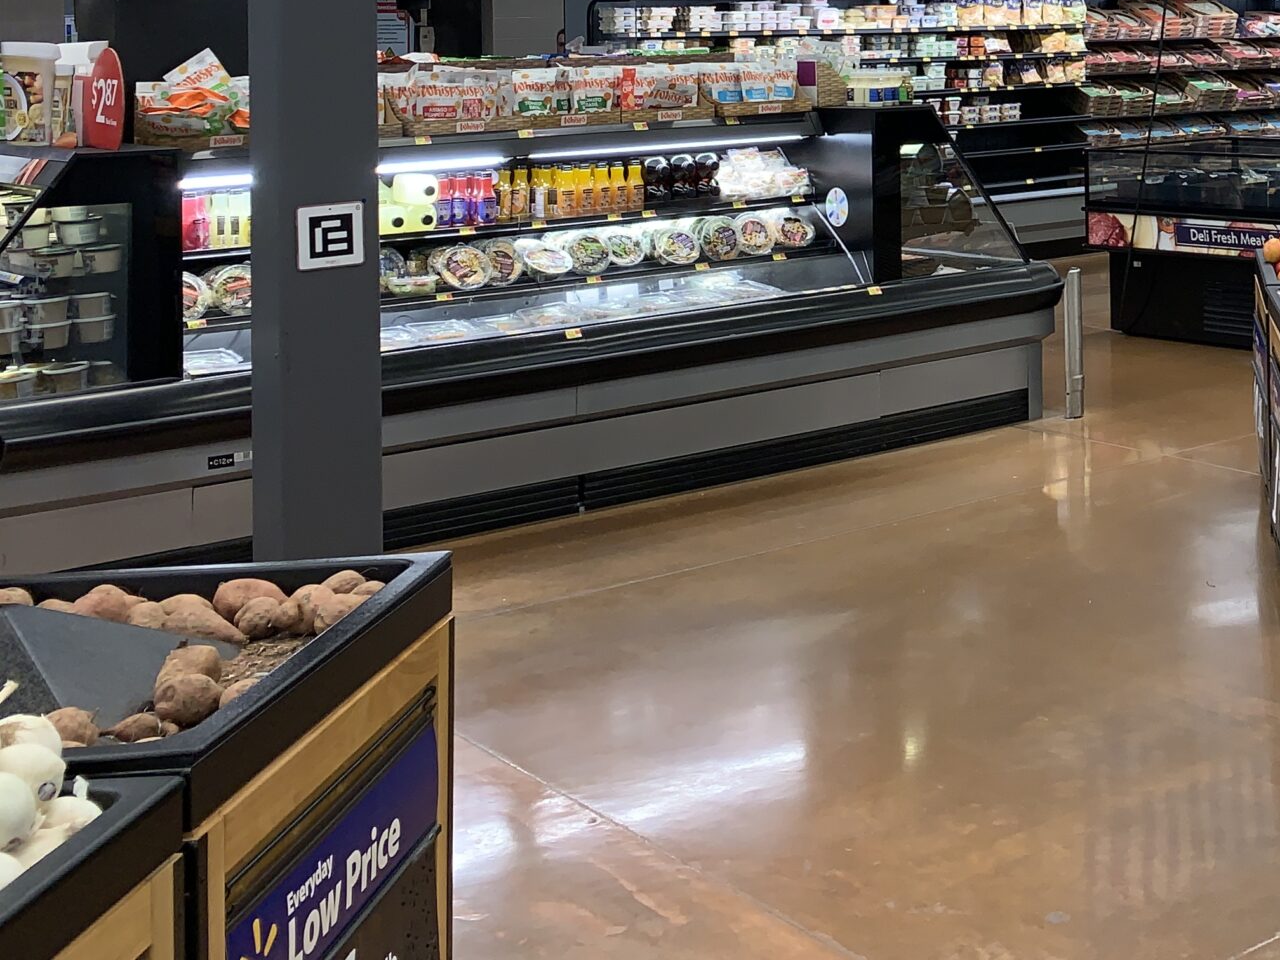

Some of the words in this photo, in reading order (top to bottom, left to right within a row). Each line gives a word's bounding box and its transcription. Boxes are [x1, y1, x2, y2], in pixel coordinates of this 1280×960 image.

[1190, 228, 1210, 242] Deli
[1211, 230, 1239, 244] Fresh
[1240, 233, 1266, 247] Meat
[286, 854, 333, 916] Everyday
[288, 880, 342, 960] Low
[345, 817, 401, 910] Price
